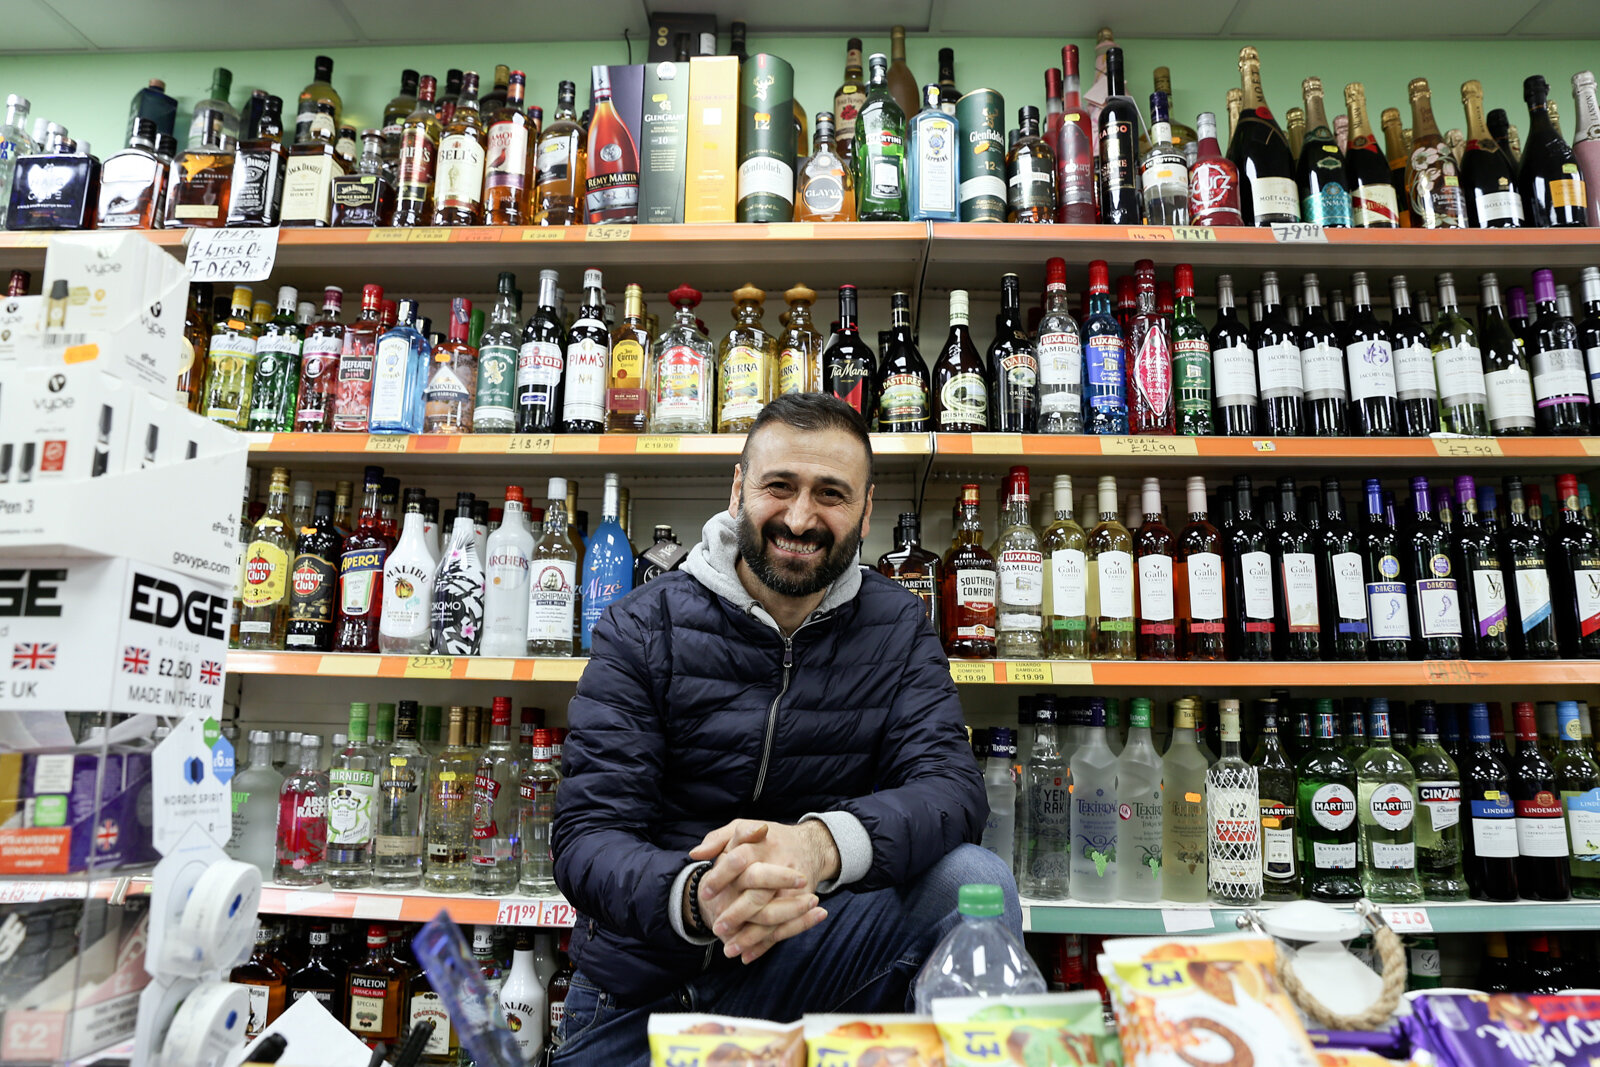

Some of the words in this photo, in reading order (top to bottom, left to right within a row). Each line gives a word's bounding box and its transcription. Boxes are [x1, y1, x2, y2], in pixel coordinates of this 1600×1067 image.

[440, 149, 478, 163] BELL'S
[588, 176, 608, 188] RÉMY
[609, 173, 637, 184] MARTIN
[85, 262, 122, 277] vype
[140, 315, 167, 338] vype
[1042, 336, 1078, 345] LUXARDO
[1091, 337, 1125, 347] LUXARDO
[1175, 341, 1209, 351] LUXARDO
[1039, 346, 1080, 355] SAMBUCA
[519, 356, 563, 369] PERNOD
[569, 352, 604, 368] PIMM'S
[617, 353, 638, 363] Cuervo
[660, 363, 700, 375] SIERRA
[724, 362, 758, 376] SIERRA
[780, 364, 799, 376] ERRA
[828, 363, 844, 378] Tia
[843, 366, 869, 377] Maria
[883, 377, 922, 390] PASTURES
[33, 396, 75, 414] vype
[173, 551, 230, 575] govype.com
[341, 554, 381, 571] APEROL
[488, 554, 529, 570] ARCHERS
[1004, 553, 1041, 563] LUXARDO
[386, 566, 427, 583] MALIBU
[1001, 564, 1042, 573] SAMBUCA
[1058, 566, 1080, 574] Gallo
[1105, 567, 1127, 575] Gallo
[1145, 570, 1168, 578] Gallo
[1194, 569, 1217, 577] Gallo
[1249, 568, 1269, 576] Gallo
[1291, 566, 1312, 574] Gallo
[248, 571, 267, 581] Club
[960, 576, 995, 587] SOUTHERN
[295, 580, 314, 590] Club
[963, 587, 994, 597] COMFORT
[129, 572, 229, 641] EDGE
[298, 602, 306, 614] 7
[159, 658, 192, 680] £2.50
[12, 681, 38, 698] UK
[128, 685, 161, 704] MADE
[164, 690, 176, 705] IN
[176, 691, 197, 708] THE
[199, 693, 212, 709] UK
[213, 751, 233, 767] £6.50
[164, 794, 197, 805] NORDIC
[199, 793, 223, 803] SPIRIT
[1262, 807, 1295, 816] MARTINI
[1315, 801, 1353, 811] MARTINI
[1374, 801, 1411, 810] MARTINI
[498, 904, 536, 925] £11.99
[353, 978, 386, 988] APPLETON
[353, 988, 372, 996] JAMAICA
[356, 1000, 377, 1008] SPECIAL
[964, 1031, 1000, 1057] £1
